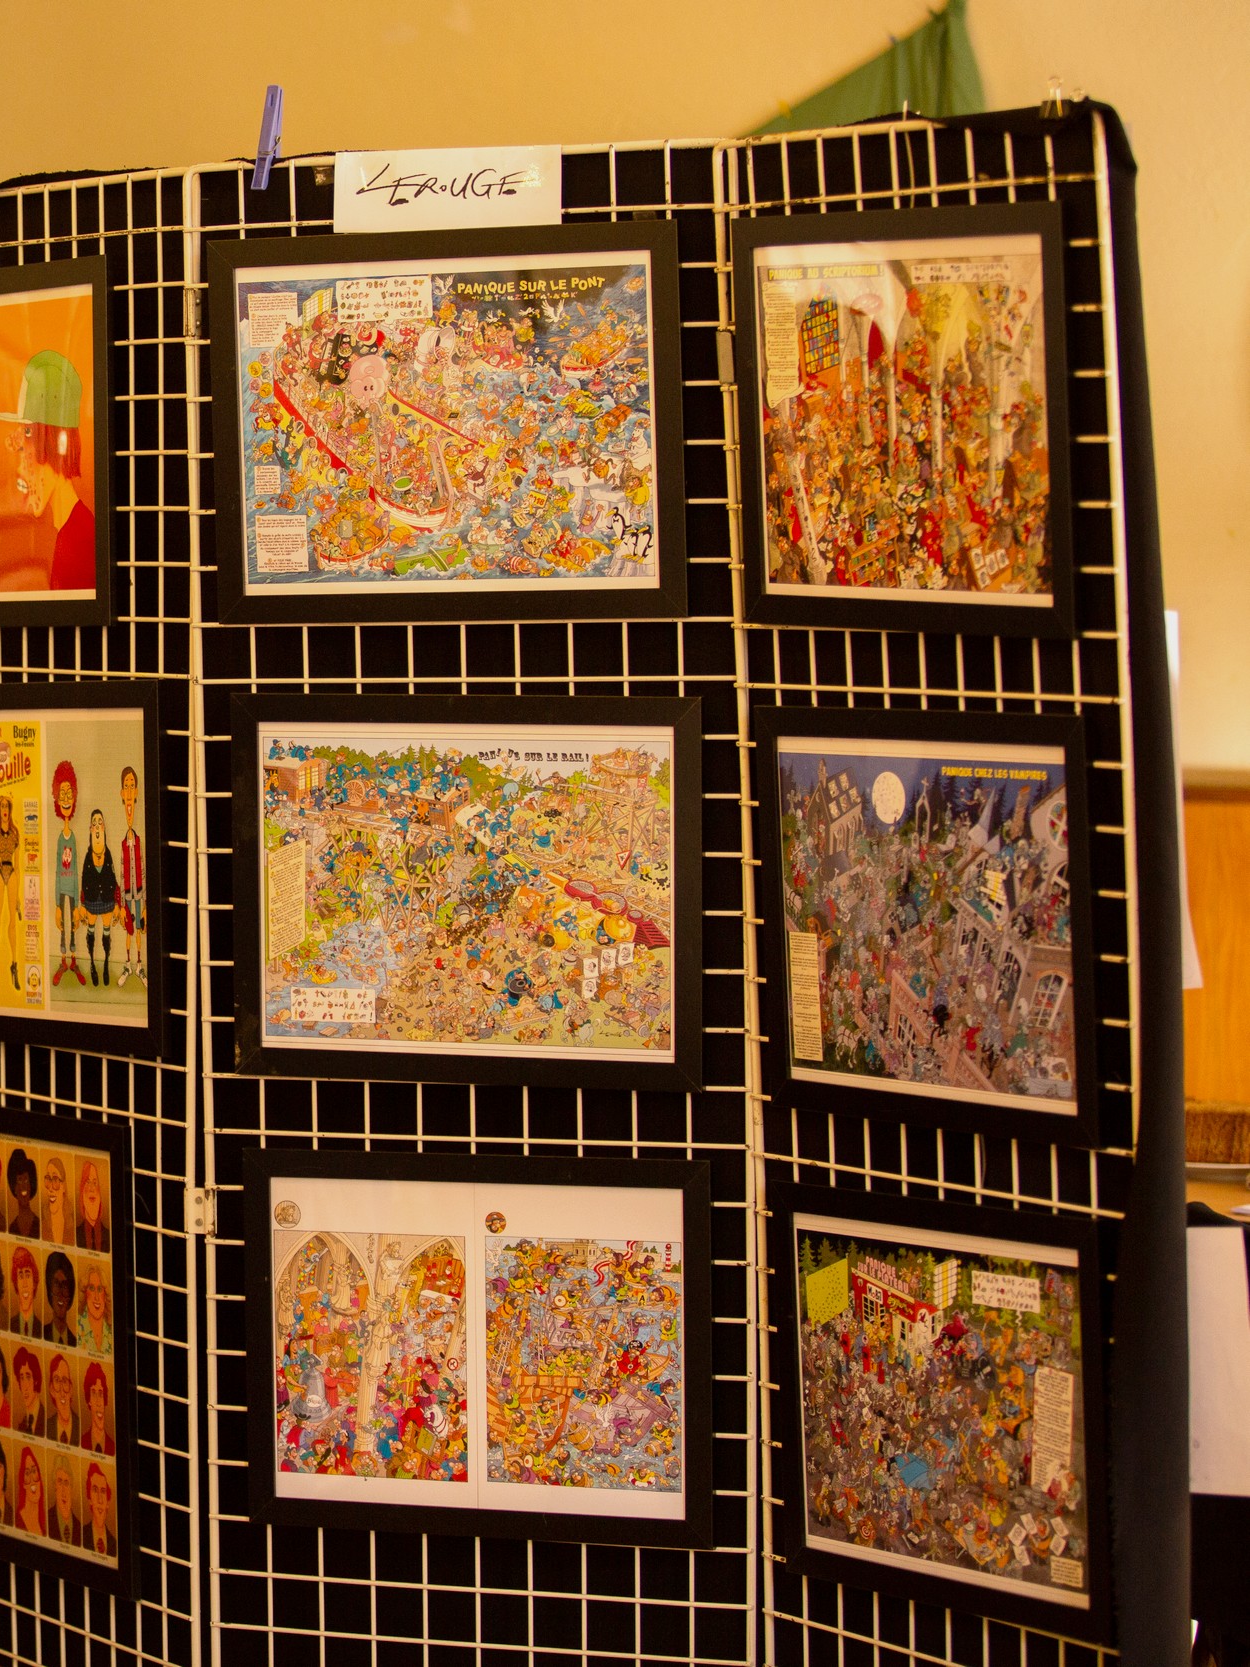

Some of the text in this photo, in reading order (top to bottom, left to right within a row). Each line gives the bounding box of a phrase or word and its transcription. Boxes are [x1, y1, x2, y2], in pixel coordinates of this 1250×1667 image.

[457, 276, 606, 295] PANIQUE SUR LE PONT
[13, 725, 36, 741] Bugny
[524, 752, 543, 762] SUR
[546, 752, 558, 762] LE
[561, 752, 584, 762] RAIL
[993, 768, 1008, 779] LES
